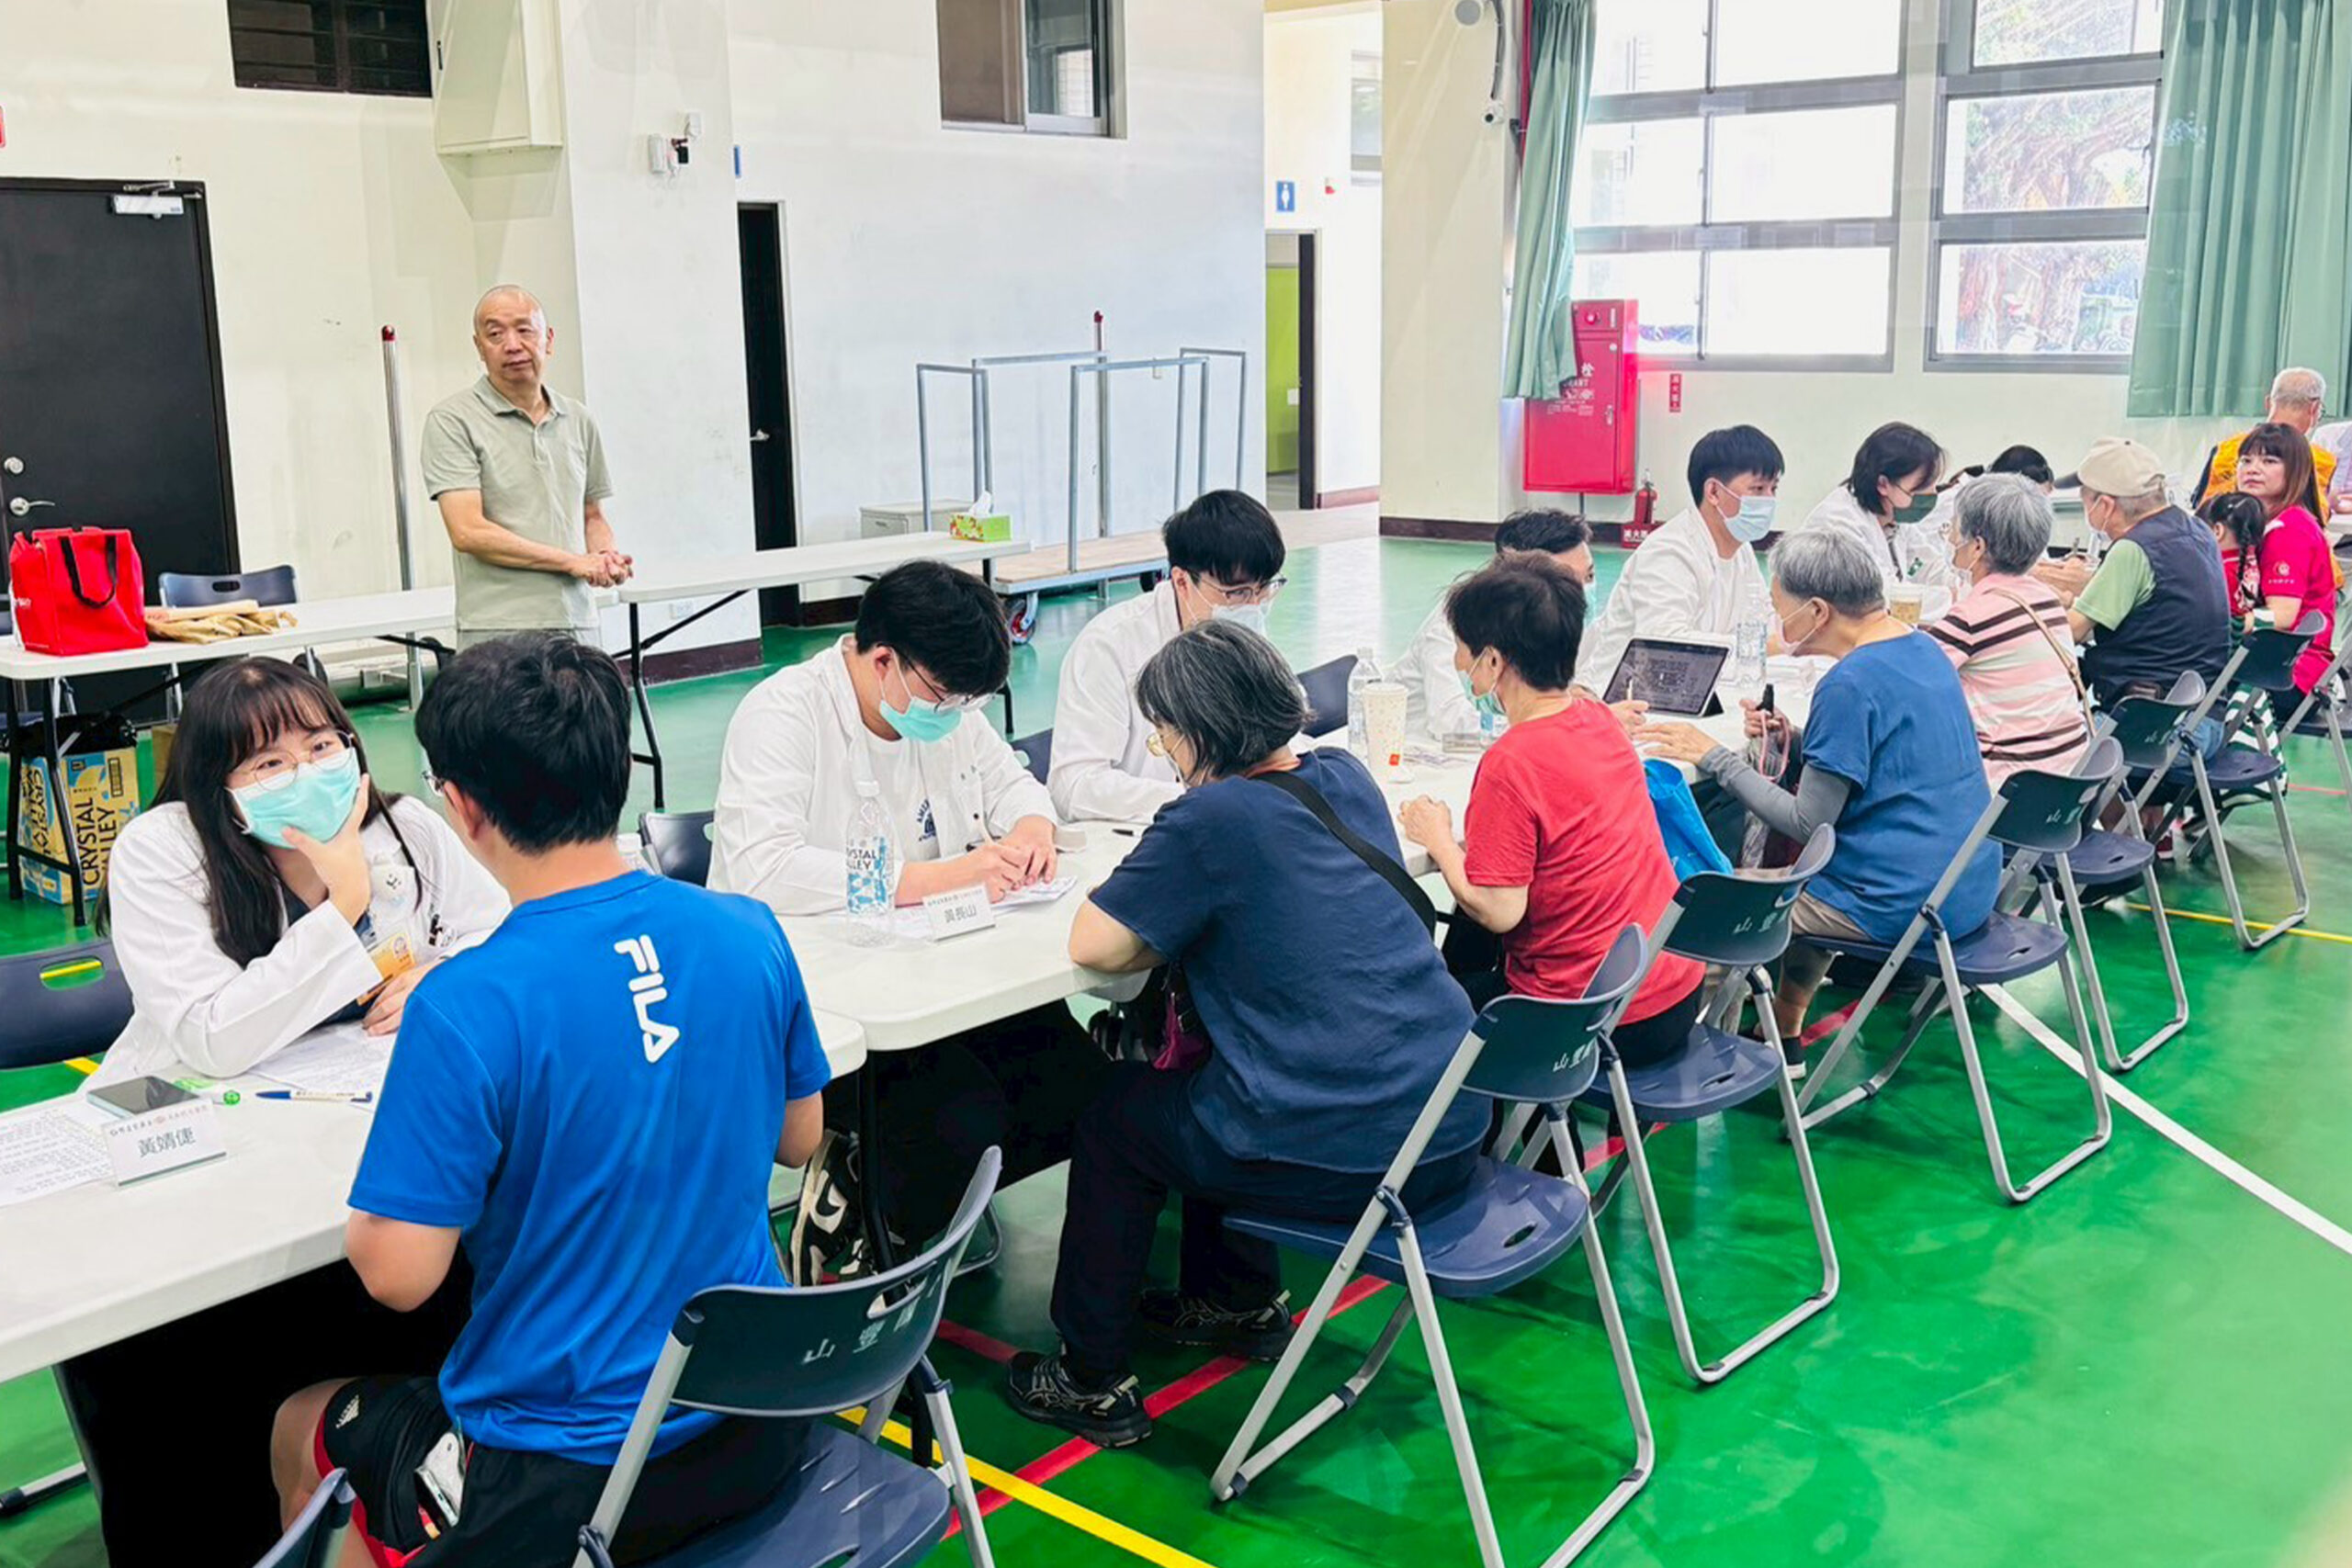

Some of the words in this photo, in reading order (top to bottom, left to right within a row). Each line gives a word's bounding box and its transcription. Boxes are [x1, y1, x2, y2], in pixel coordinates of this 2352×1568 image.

[74, 797, 100, 885] CRYSTAL
[96, 807, 118, 871] LEY
[613, 934, 680, 1063] FILA
